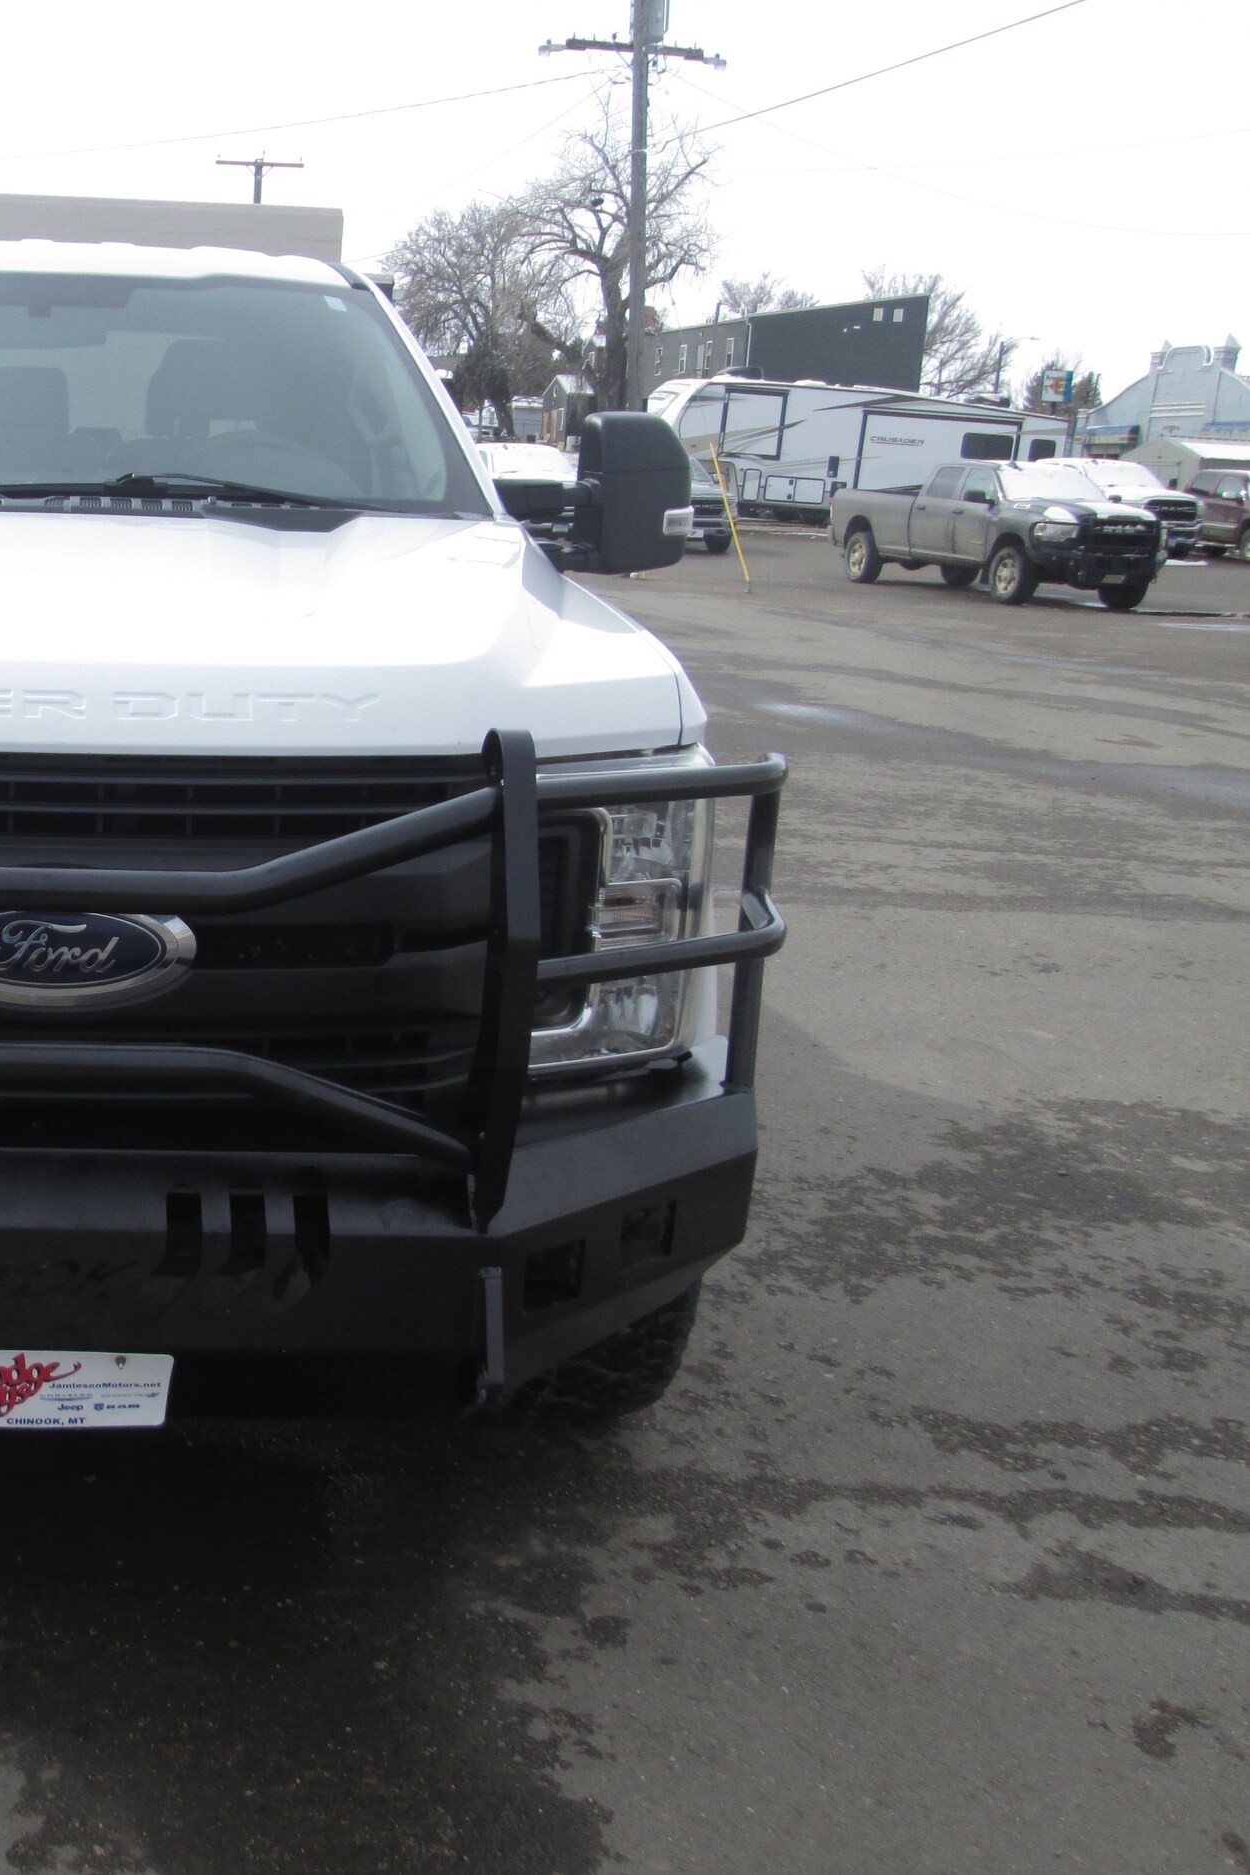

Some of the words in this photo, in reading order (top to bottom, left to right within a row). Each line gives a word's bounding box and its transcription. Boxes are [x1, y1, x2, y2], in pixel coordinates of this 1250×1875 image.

[870, 435, 925, 445] CRUSADER
[112, 690, 379, 723] DUTY
[48, 1381, 162, 1390] JamiesonMotors.net
[57, 1403, 84, 1412] Jeep
[6, 1417, 65, 1426] CHINOOK,
[68, 1417, 86, 1425] MT
